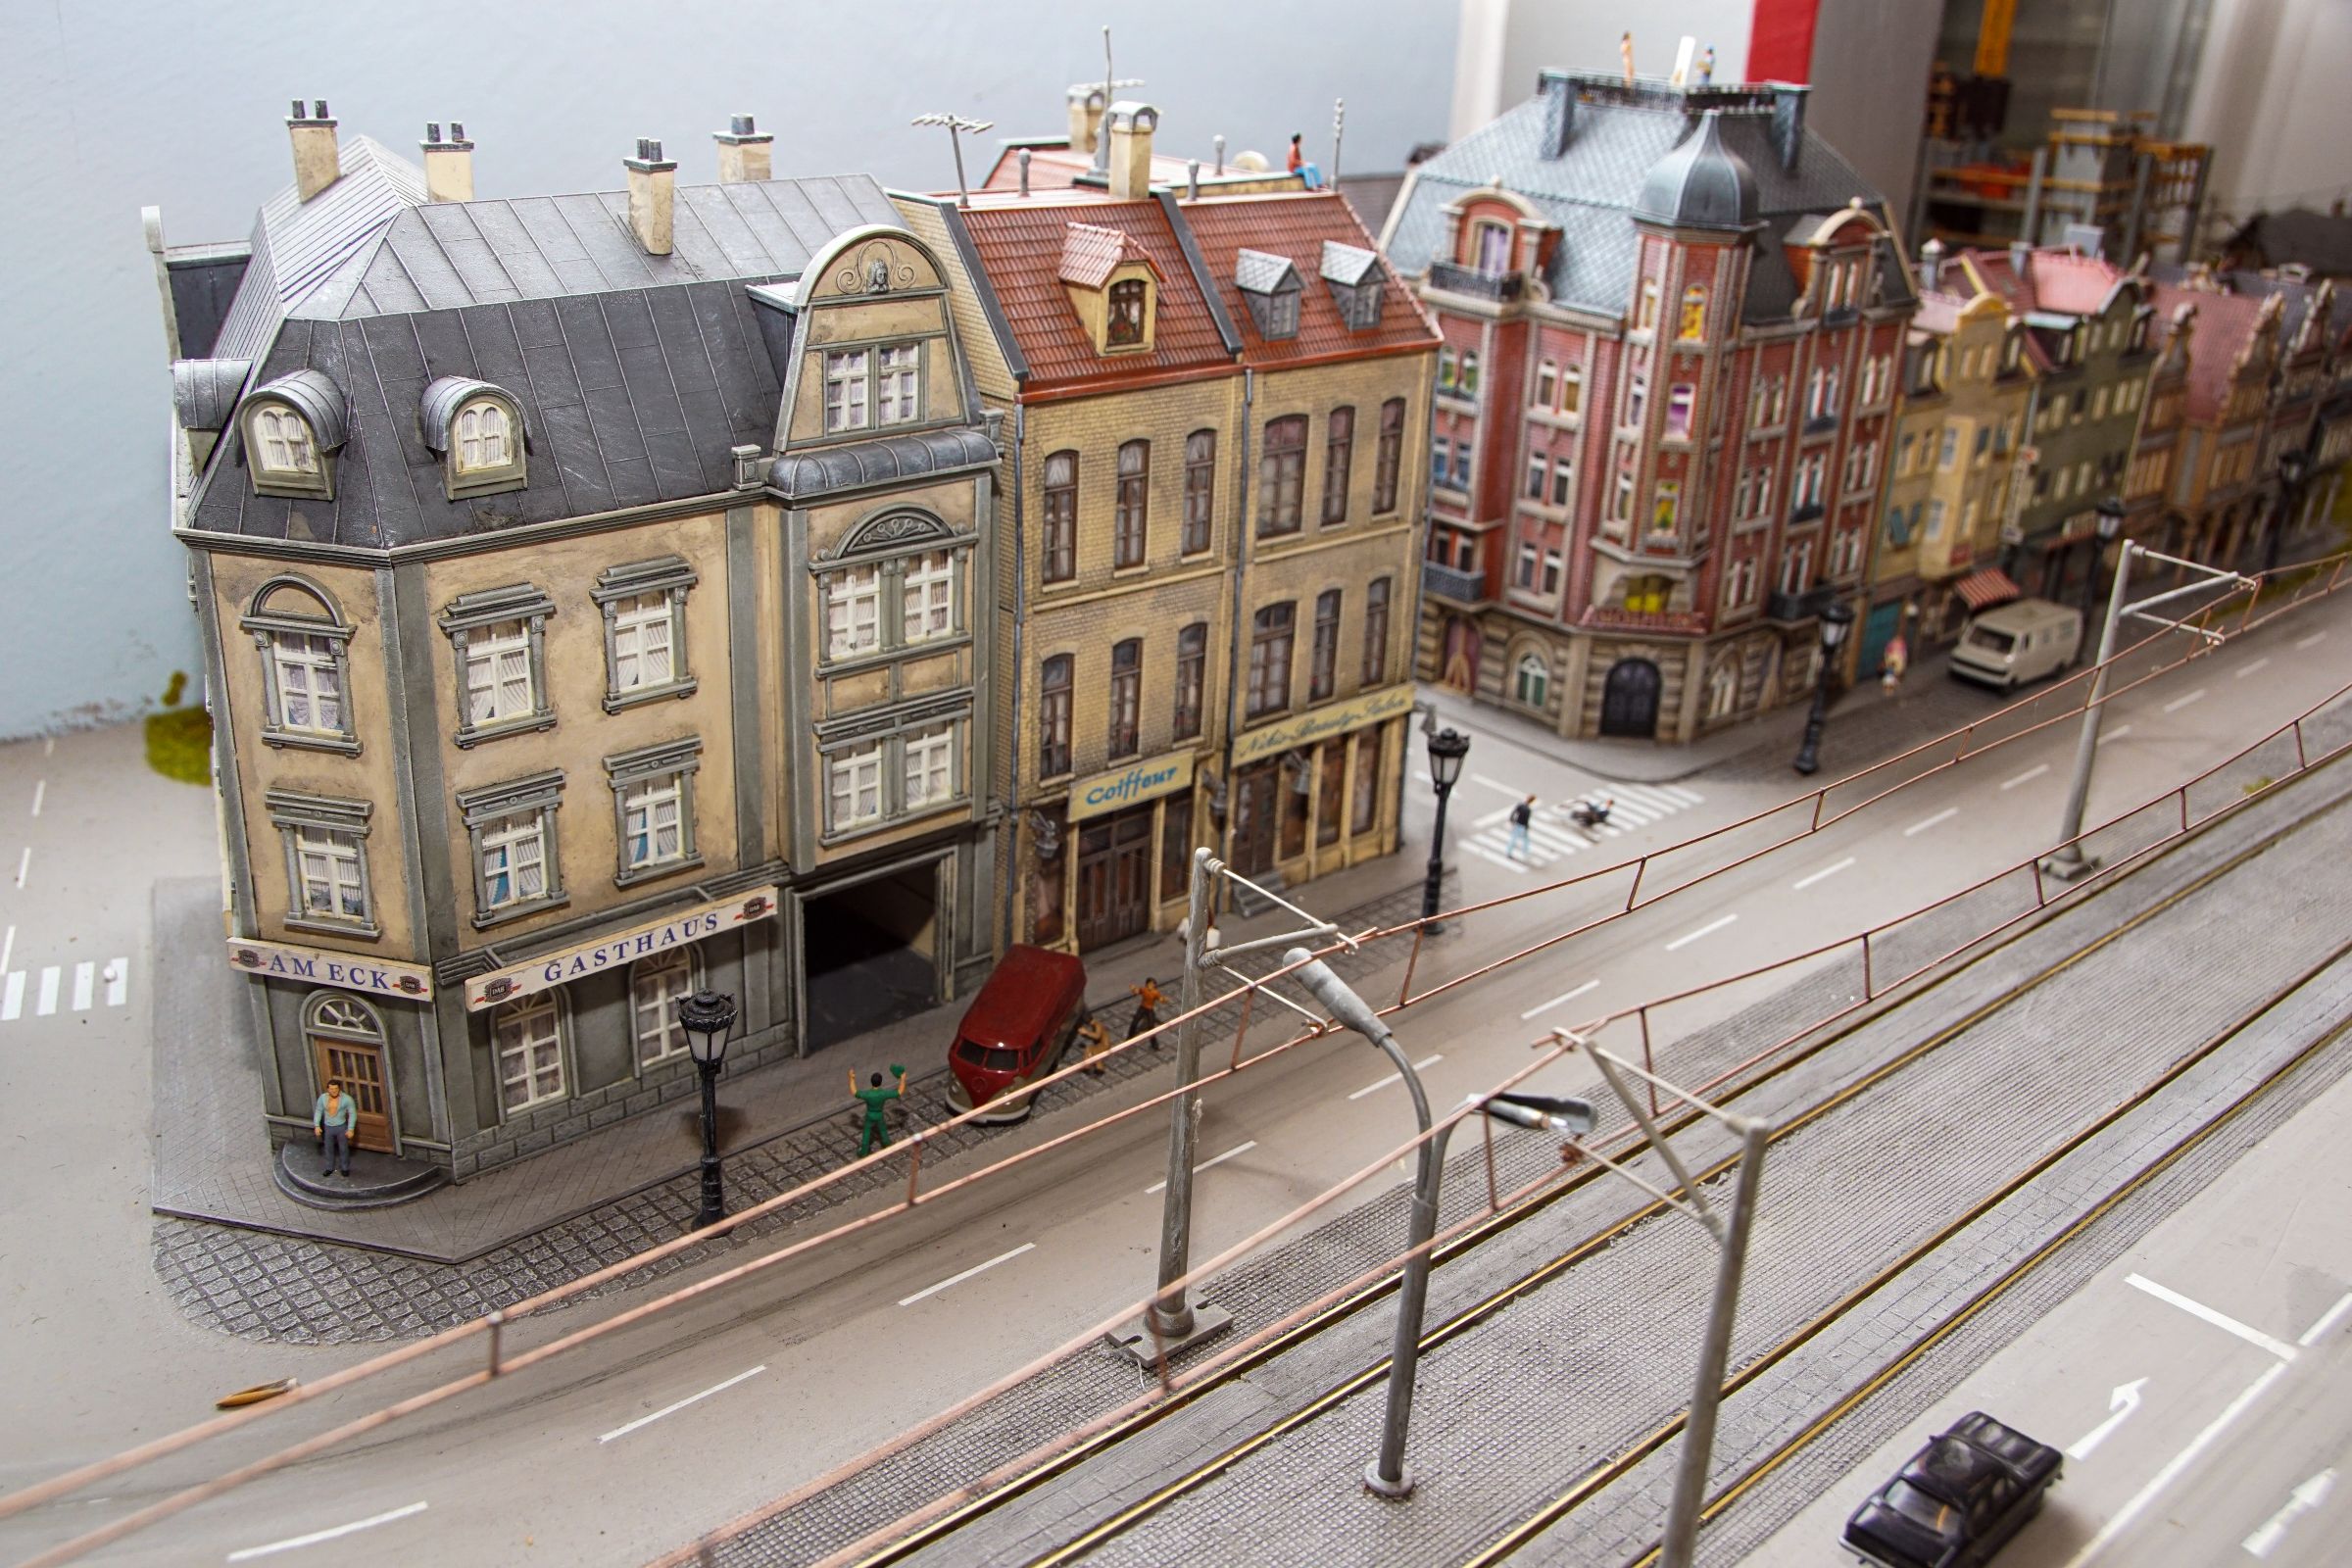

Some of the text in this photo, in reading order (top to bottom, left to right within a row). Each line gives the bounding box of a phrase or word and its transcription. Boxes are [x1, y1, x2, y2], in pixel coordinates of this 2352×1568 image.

[1086, 767, 1177, 805] Coiffeur
[544, 913, 718, 982] GASTHAUS
[269, 954, 391, 990] AM ECK
